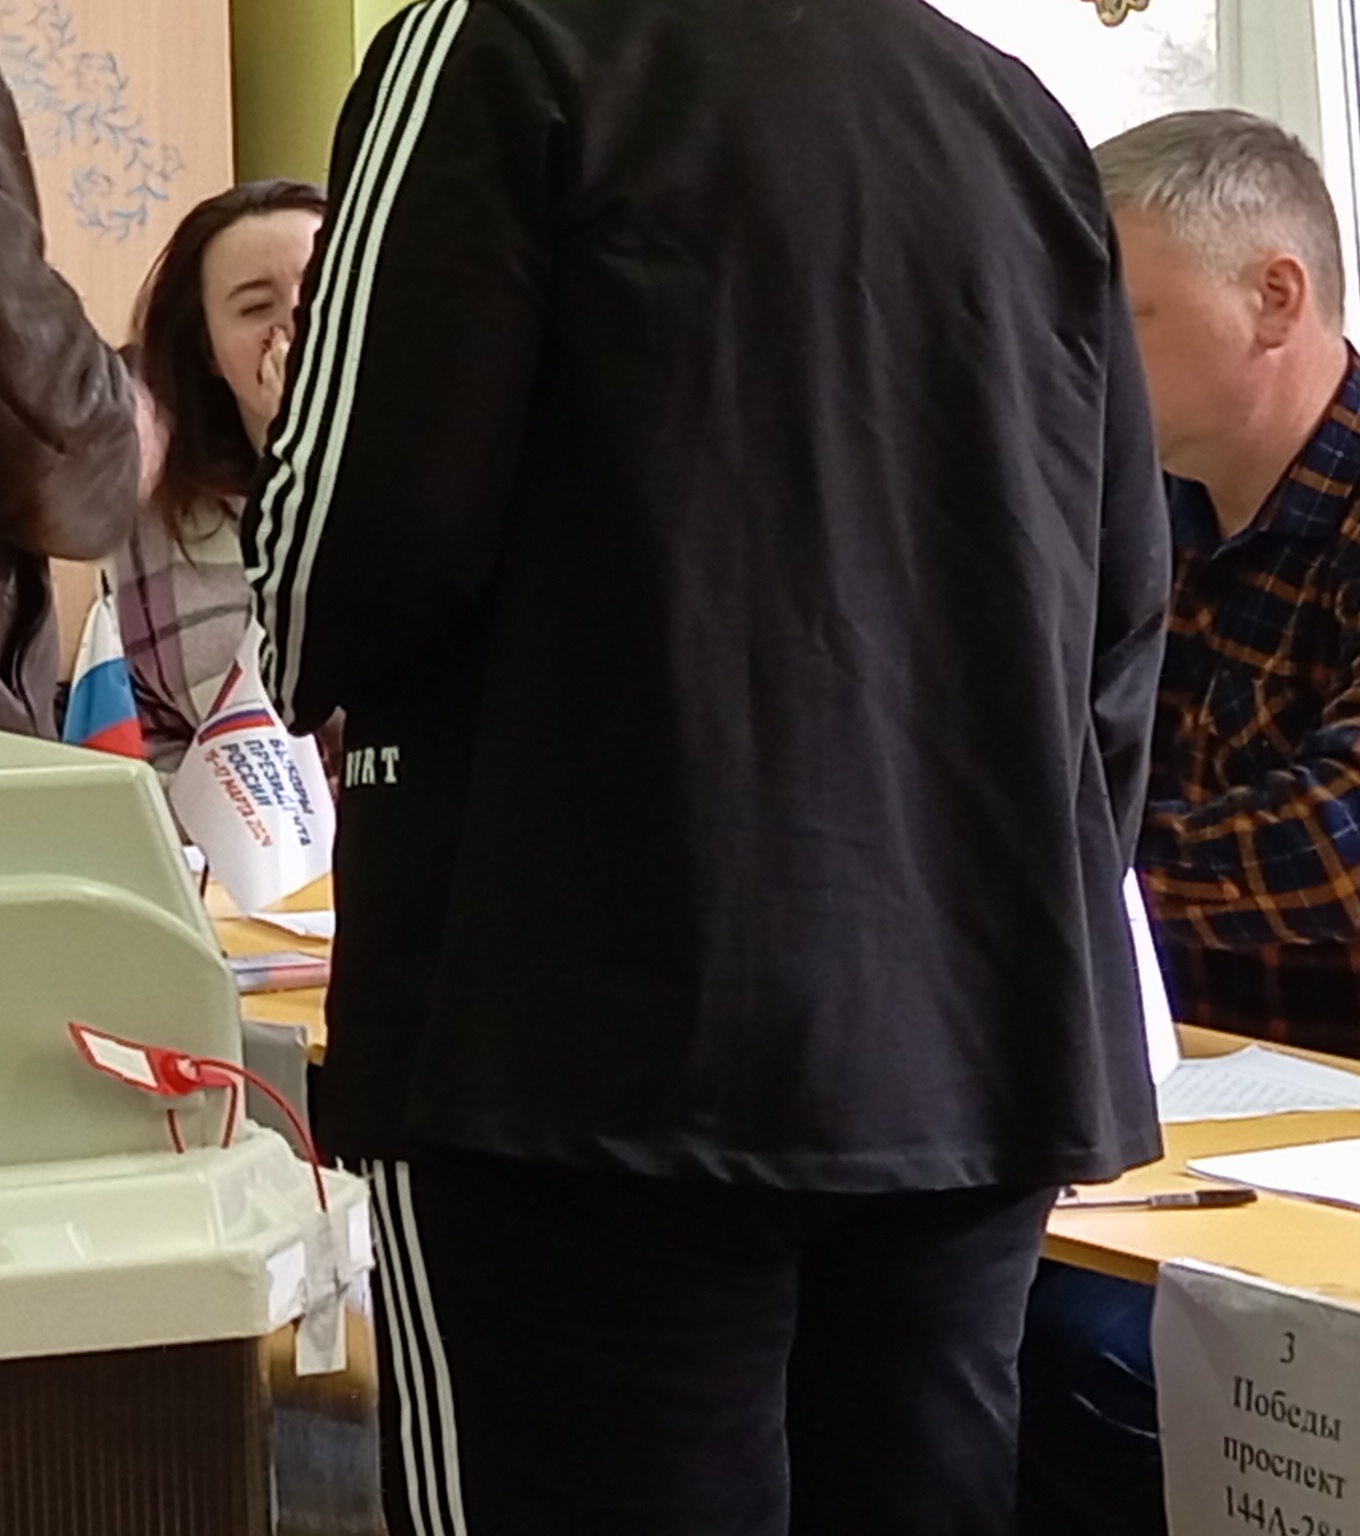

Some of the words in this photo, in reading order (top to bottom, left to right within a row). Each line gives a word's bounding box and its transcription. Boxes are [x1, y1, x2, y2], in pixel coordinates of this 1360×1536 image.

[220, 742, 274, 807] РОССИИ
[1280, 1331, 1296, 1364] 3
[1233, 1375, 1342, 1442] Победы
[1223, 1435, 1347, 1500] проспект
